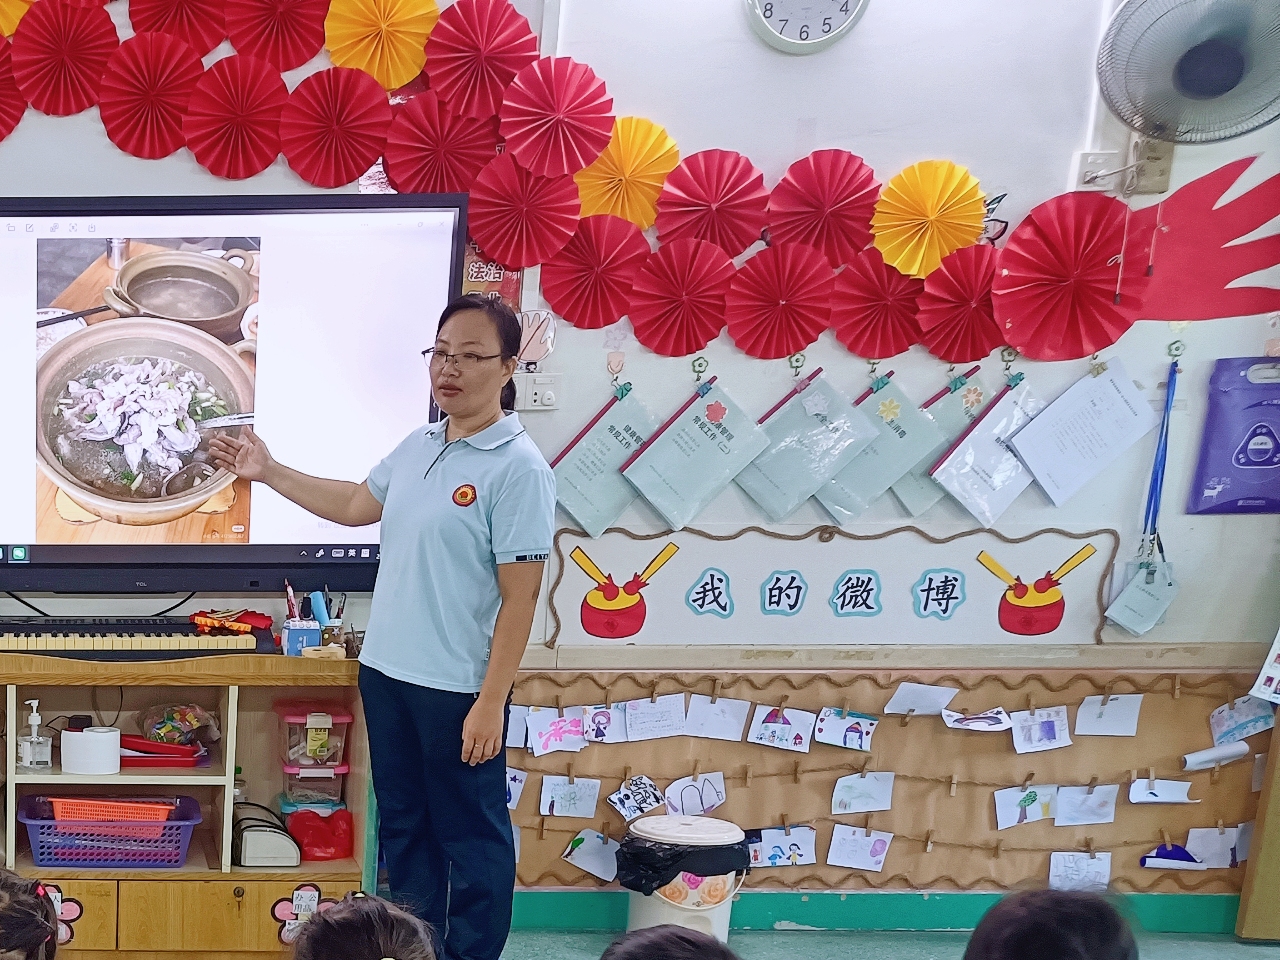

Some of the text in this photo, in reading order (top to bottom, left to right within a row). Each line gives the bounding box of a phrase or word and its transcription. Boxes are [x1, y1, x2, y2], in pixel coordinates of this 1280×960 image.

[763, 2, 774, 19] 8
[839, 0, 849, 15] 4
[778, 19, 789, 35] 7
[799, 24, 810, 41] 6
[821, 17, 832, 34] 5
[468, 262, 505, 282] 法治
[691, 573, 960, 615] 我的微博
